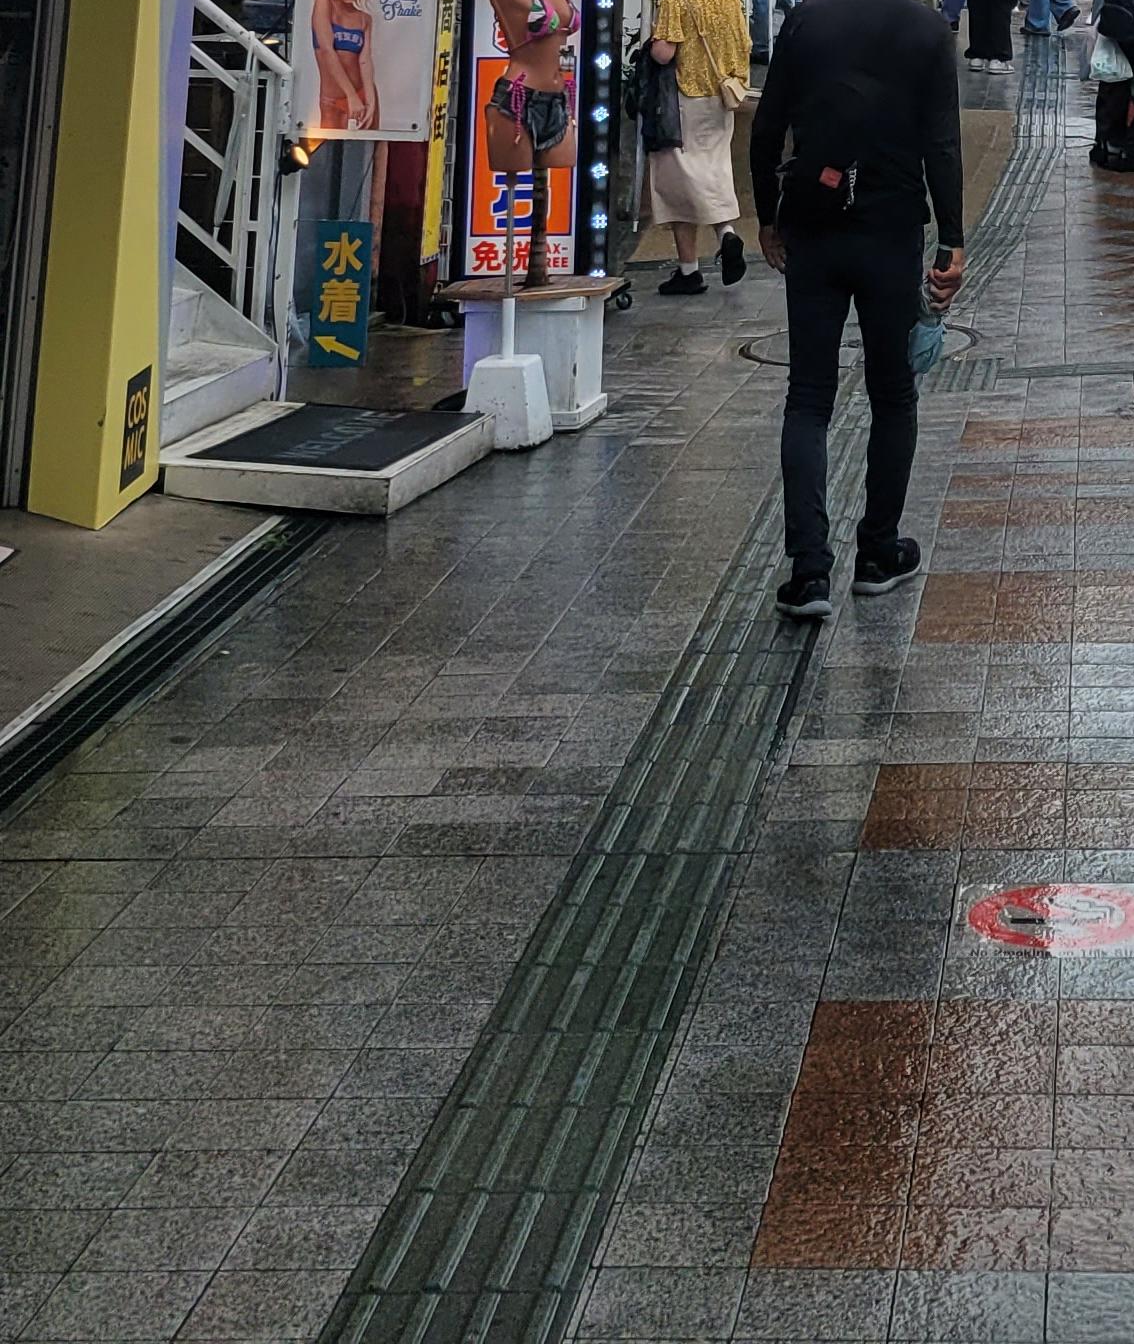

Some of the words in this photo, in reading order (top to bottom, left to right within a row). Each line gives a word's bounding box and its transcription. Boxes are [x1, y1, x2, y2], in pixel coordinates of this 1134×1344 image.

[318, 231, 365, 324] 水着
[127, 386, 149, 429] COS
[123, 428, 146, 472] MIC
